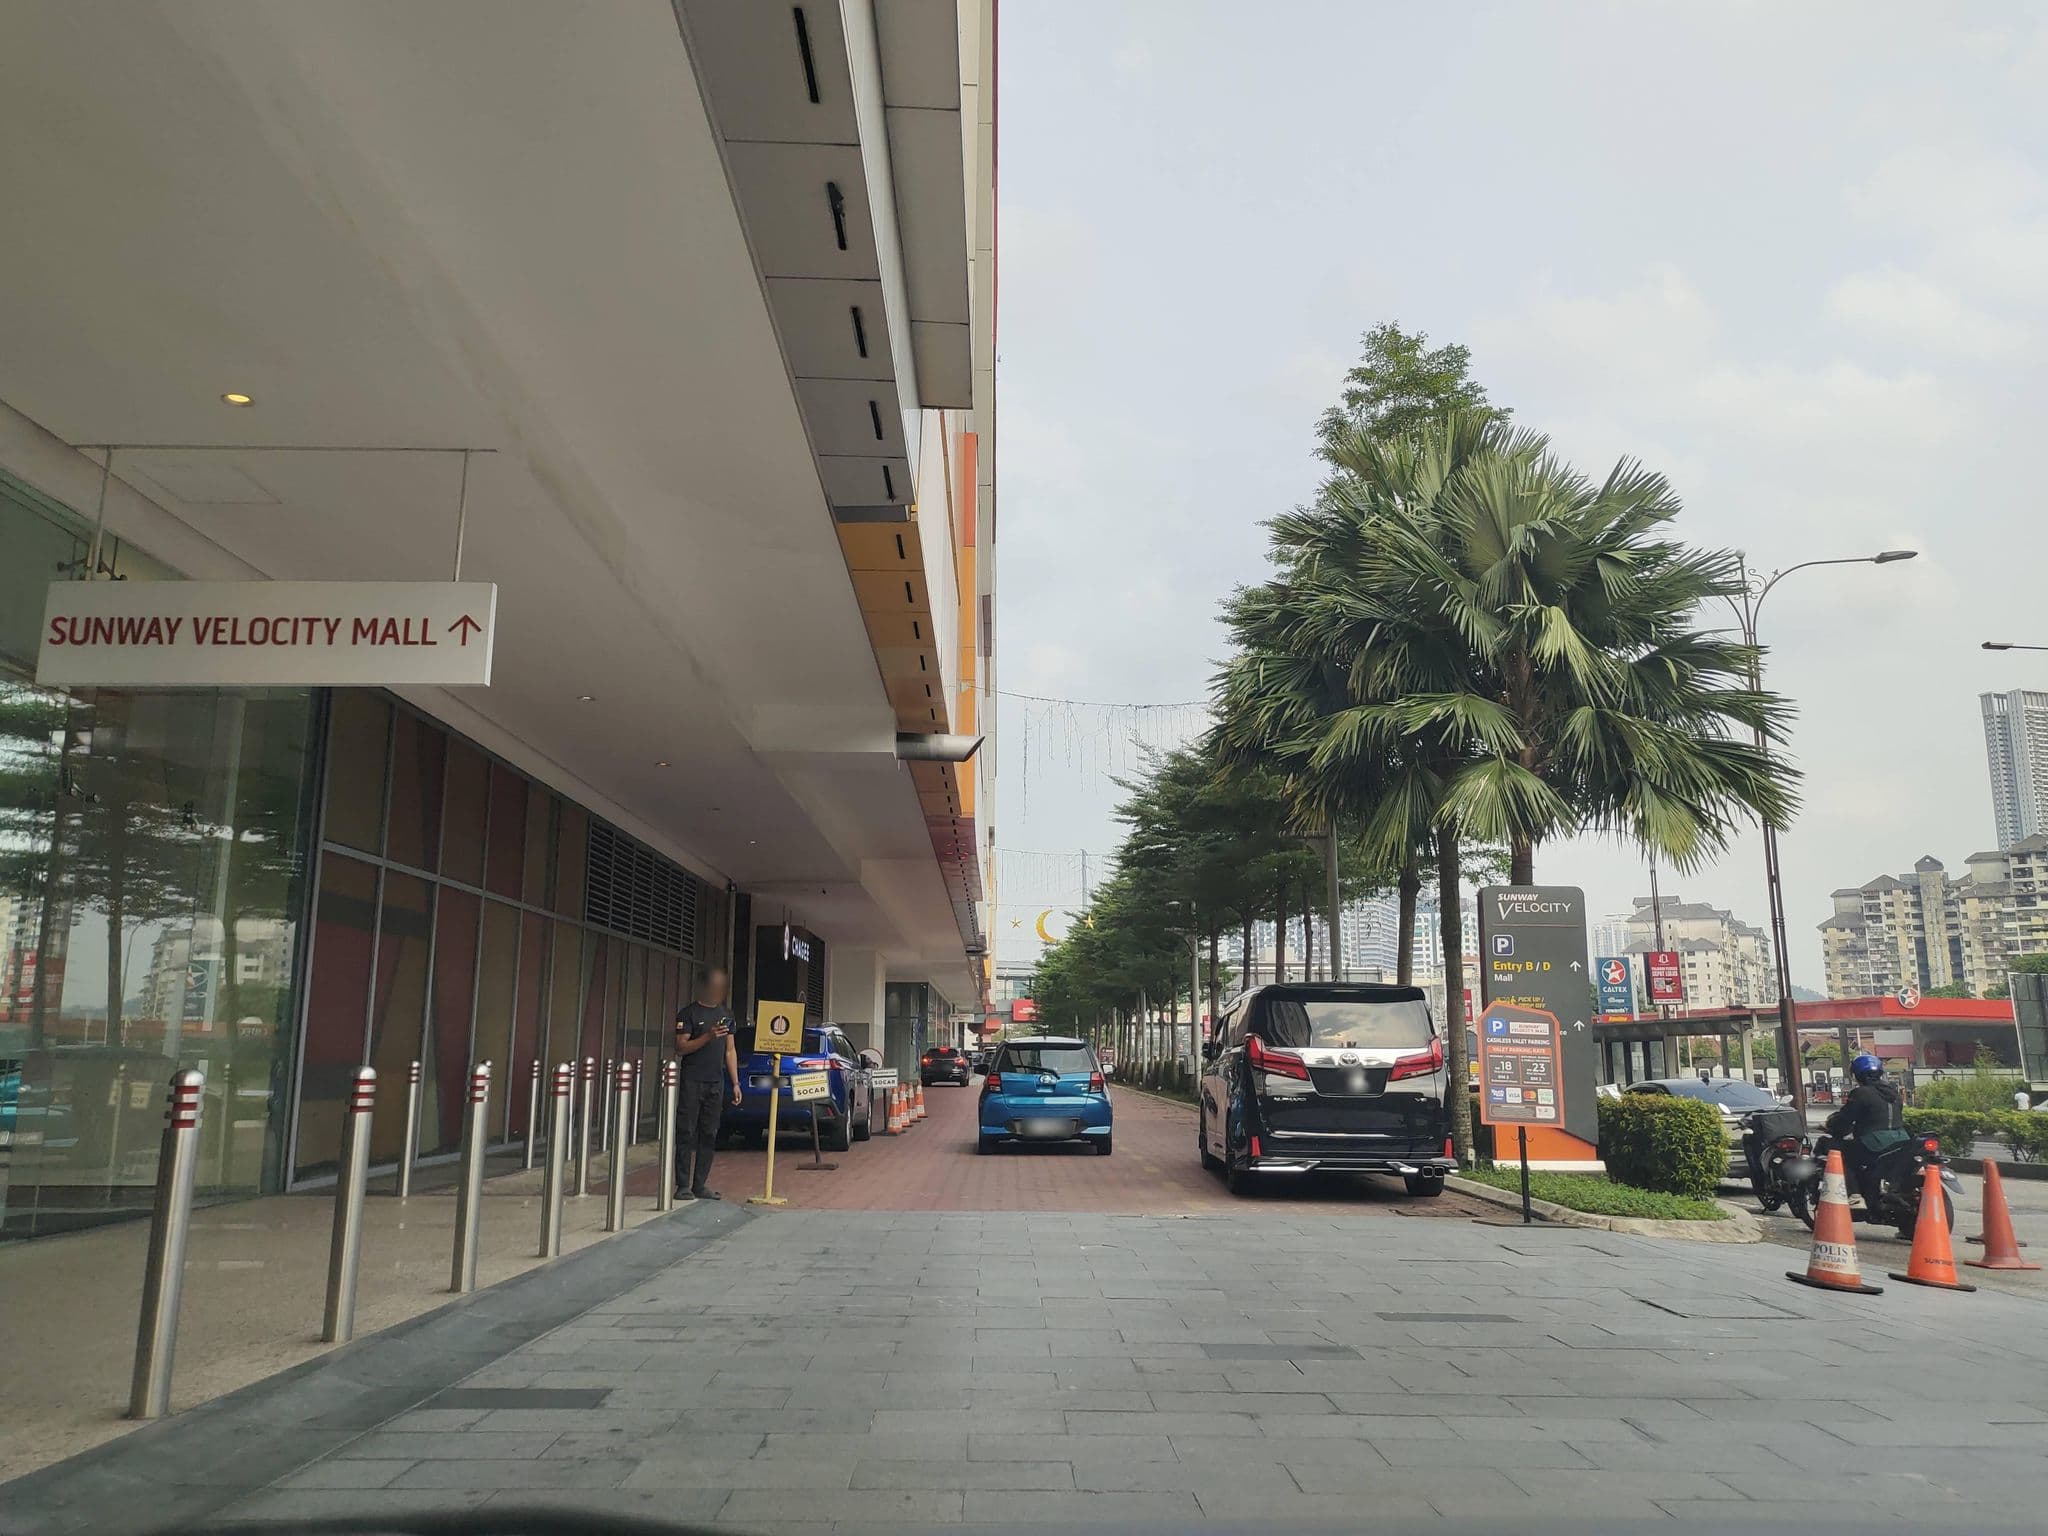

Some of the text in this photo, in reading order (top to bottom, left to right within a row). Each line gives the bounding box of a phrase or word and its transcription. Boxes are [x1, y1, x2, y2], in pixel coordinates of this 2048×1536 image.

[48, 615, 438, 647] SUNWAY VELOCITY MALL
[1497, 893, 1539, 901] SUNWAY
[1497, 902, 1572, 921] VELOCITY
[1493, 960, 1523, 973] Entry
[1525, 961, 1534, 971] B
[1542, 961, 1551, 971] D
[1494, 973, 1513, 982] Mall
[1500, 1061, 1512, 1071] 18
[1532, 1063, 1546, 1072] 23
[797, 1087, 825, 1096] SOCAR
[1813, 1243, 1849, 1256] POLIS
